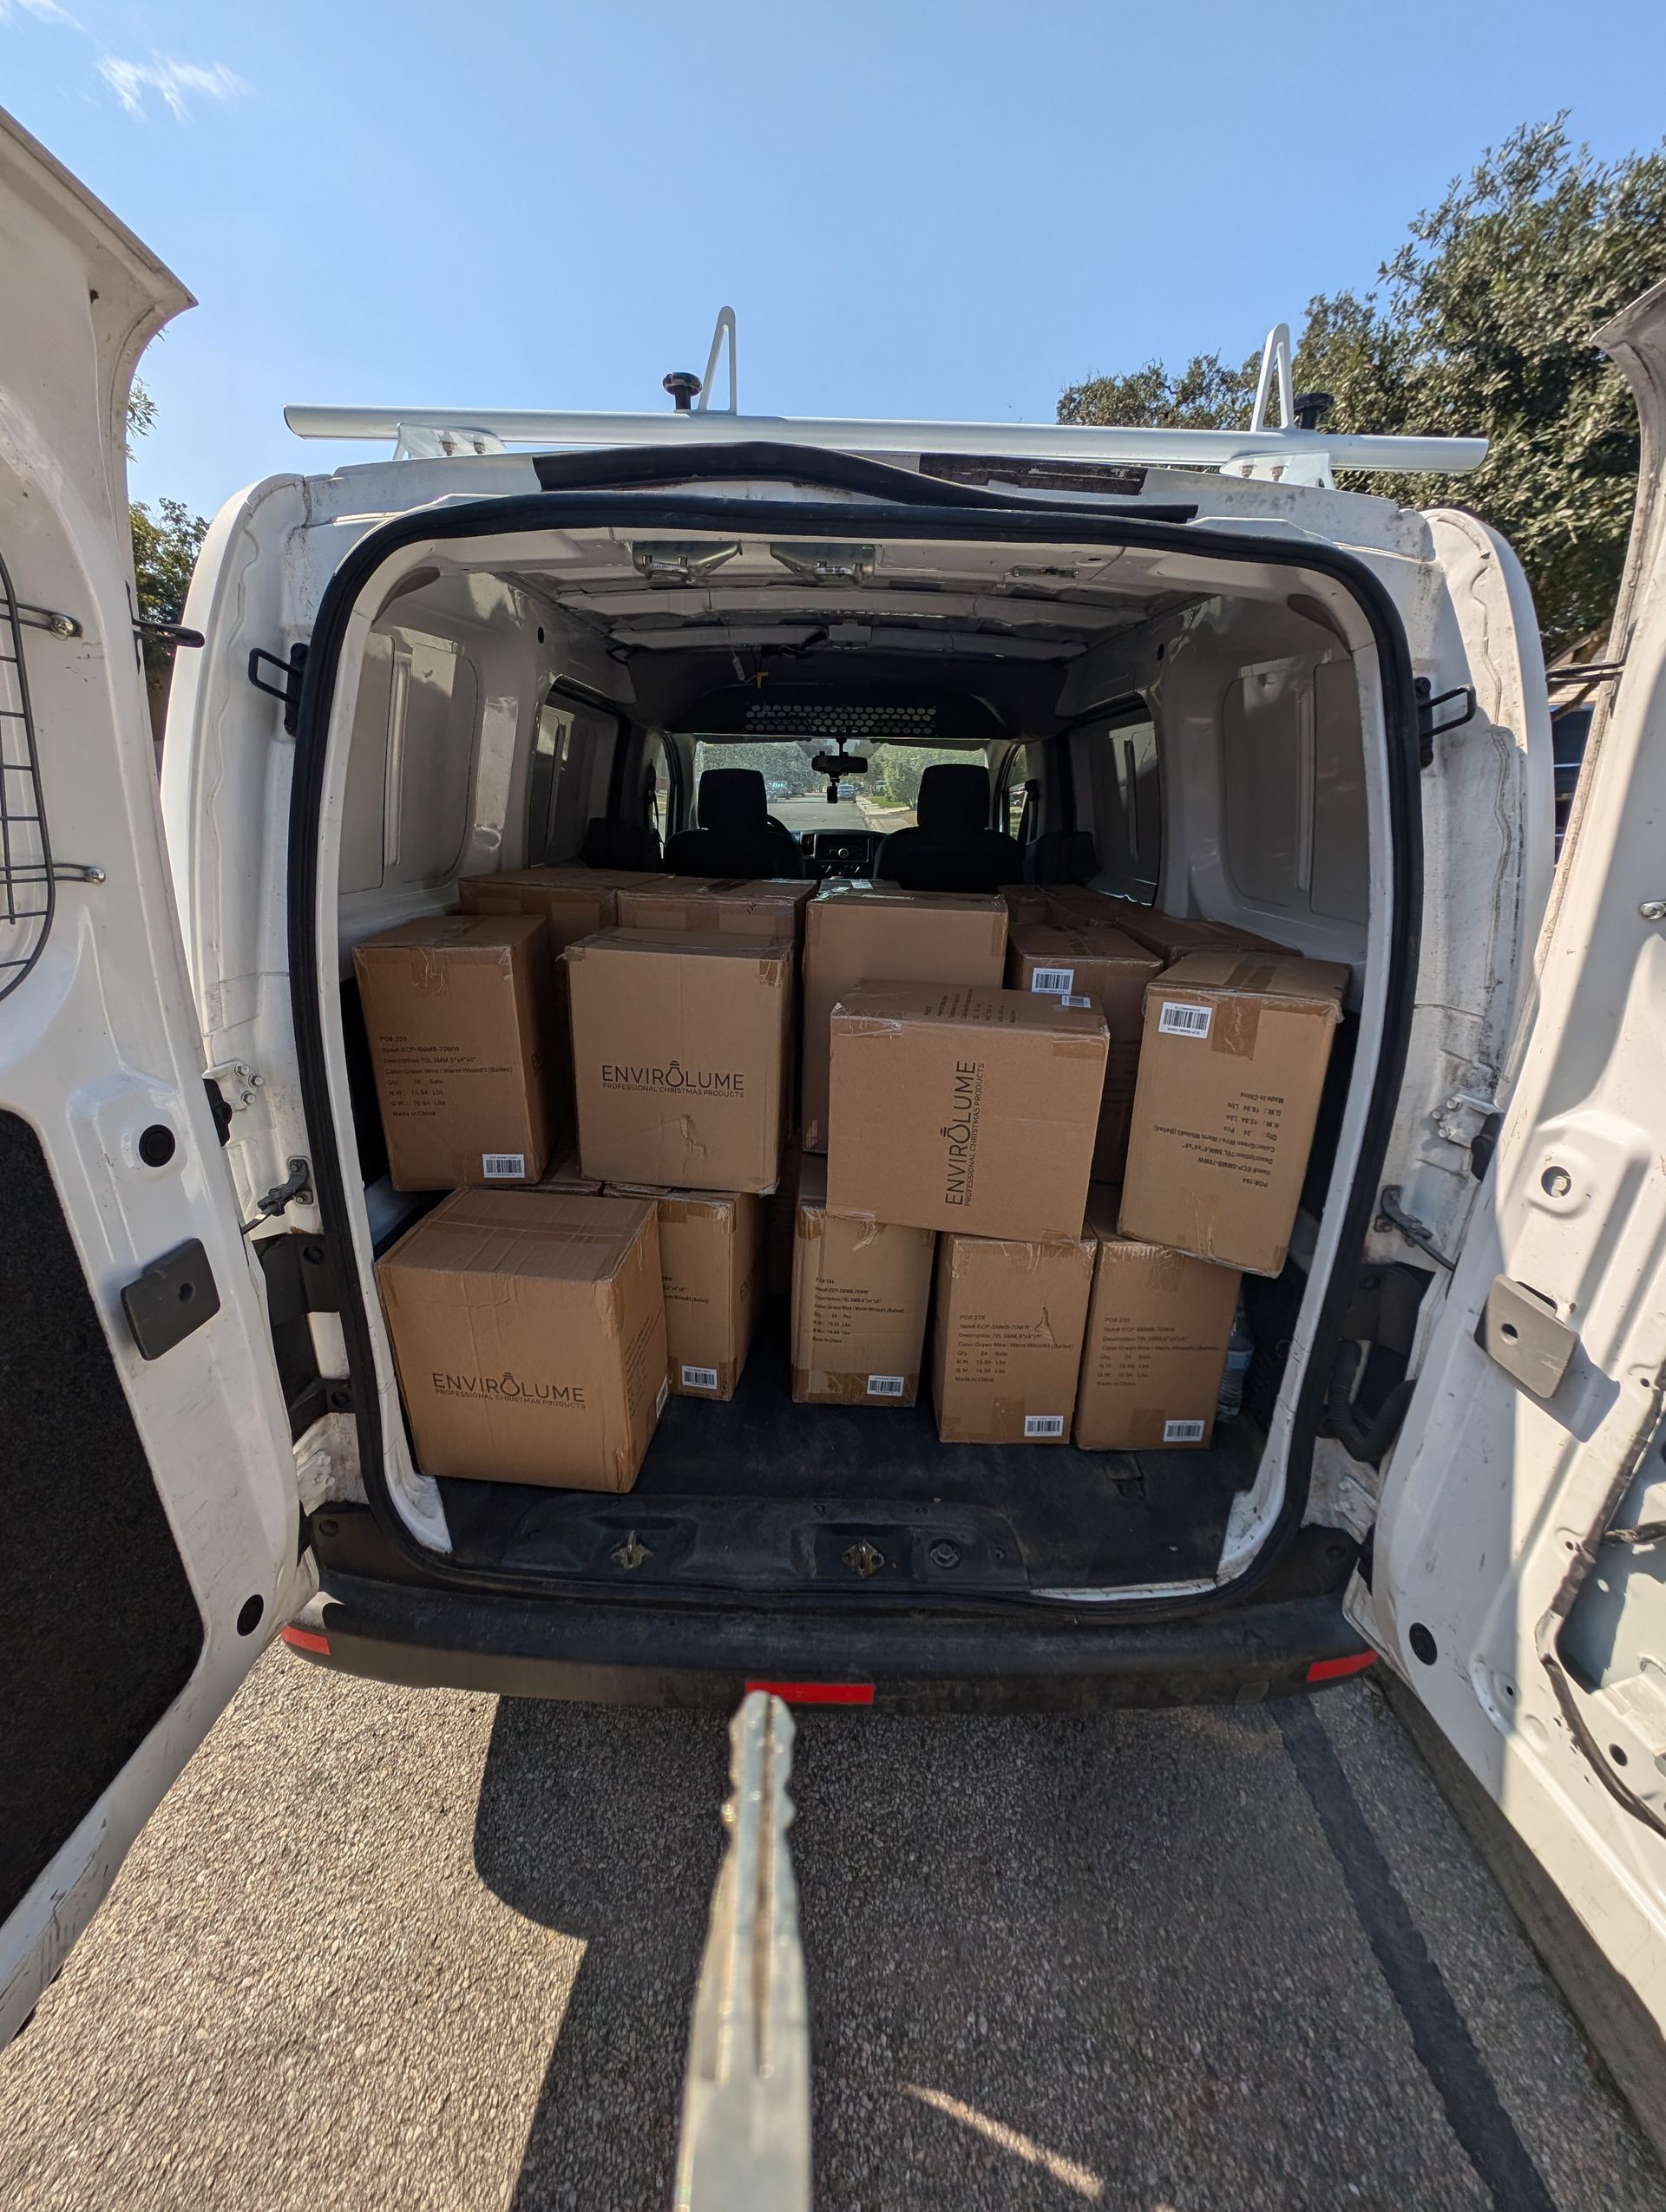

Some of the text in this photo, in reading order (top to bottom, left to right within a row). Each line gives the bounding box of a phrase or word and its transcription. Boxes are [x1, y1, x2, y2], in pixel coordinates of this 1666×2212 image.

[602, 1060, 744, 1090] ENVIROLUME
[602, 1082, 744, 1098] PROFESSIONAL CHRISTMAS PRODUCTS
[1240, 1091, 1258, 1101] China
[940, 1061, 976, 1206] ENVIROLUME
[964, 1063, 985, 1207] PROFESSIONAL CHRISTMAS PRODUCTS
[1222, 1137, 1236, 1146] Wire
[431, 1371, 586, 1403] ENVIROLUME
[435, 1388, 587, 1410] PROFESSIONAL CHRISTMAS PRODUCTS
